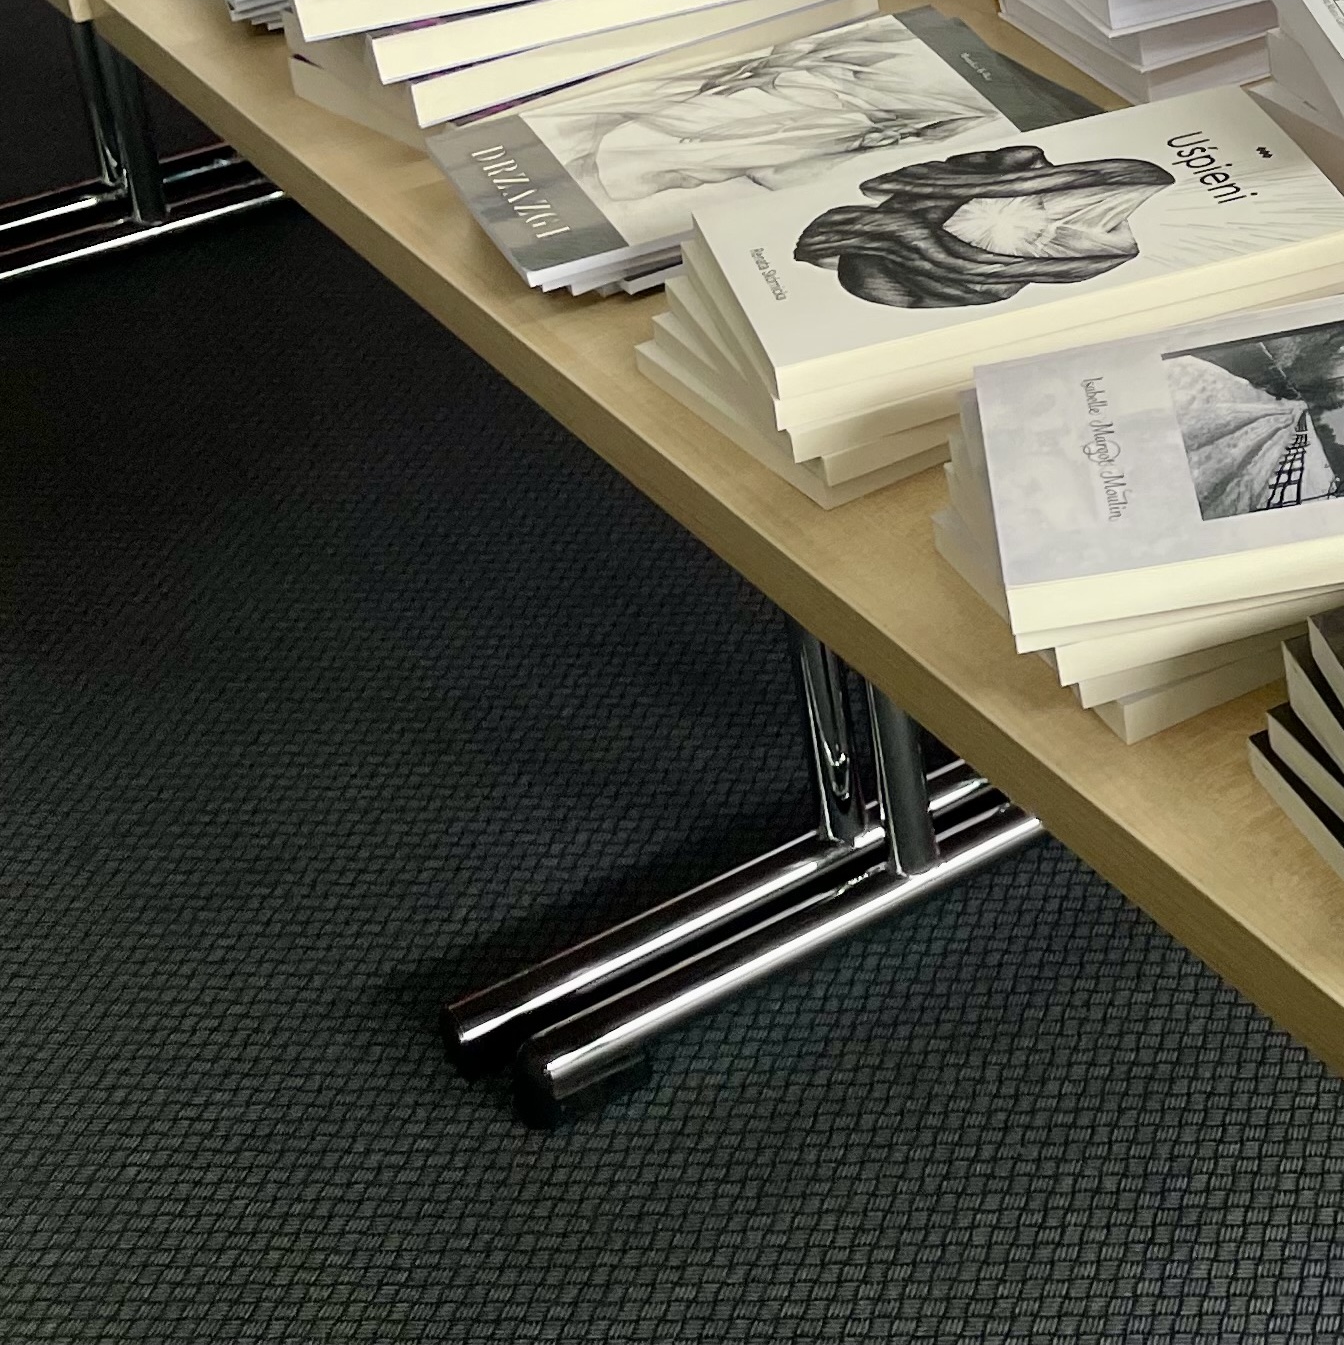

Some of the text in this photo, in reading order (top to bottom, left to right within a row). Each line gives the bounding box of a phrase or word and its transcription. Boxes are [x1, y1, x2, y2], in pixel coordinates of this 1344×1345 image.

[469, 142, 575, 242] DRZAZGI
[1166, 130, 1259, 205] Uśpieni
[1079, 374, 1104, 418] Isabelle
